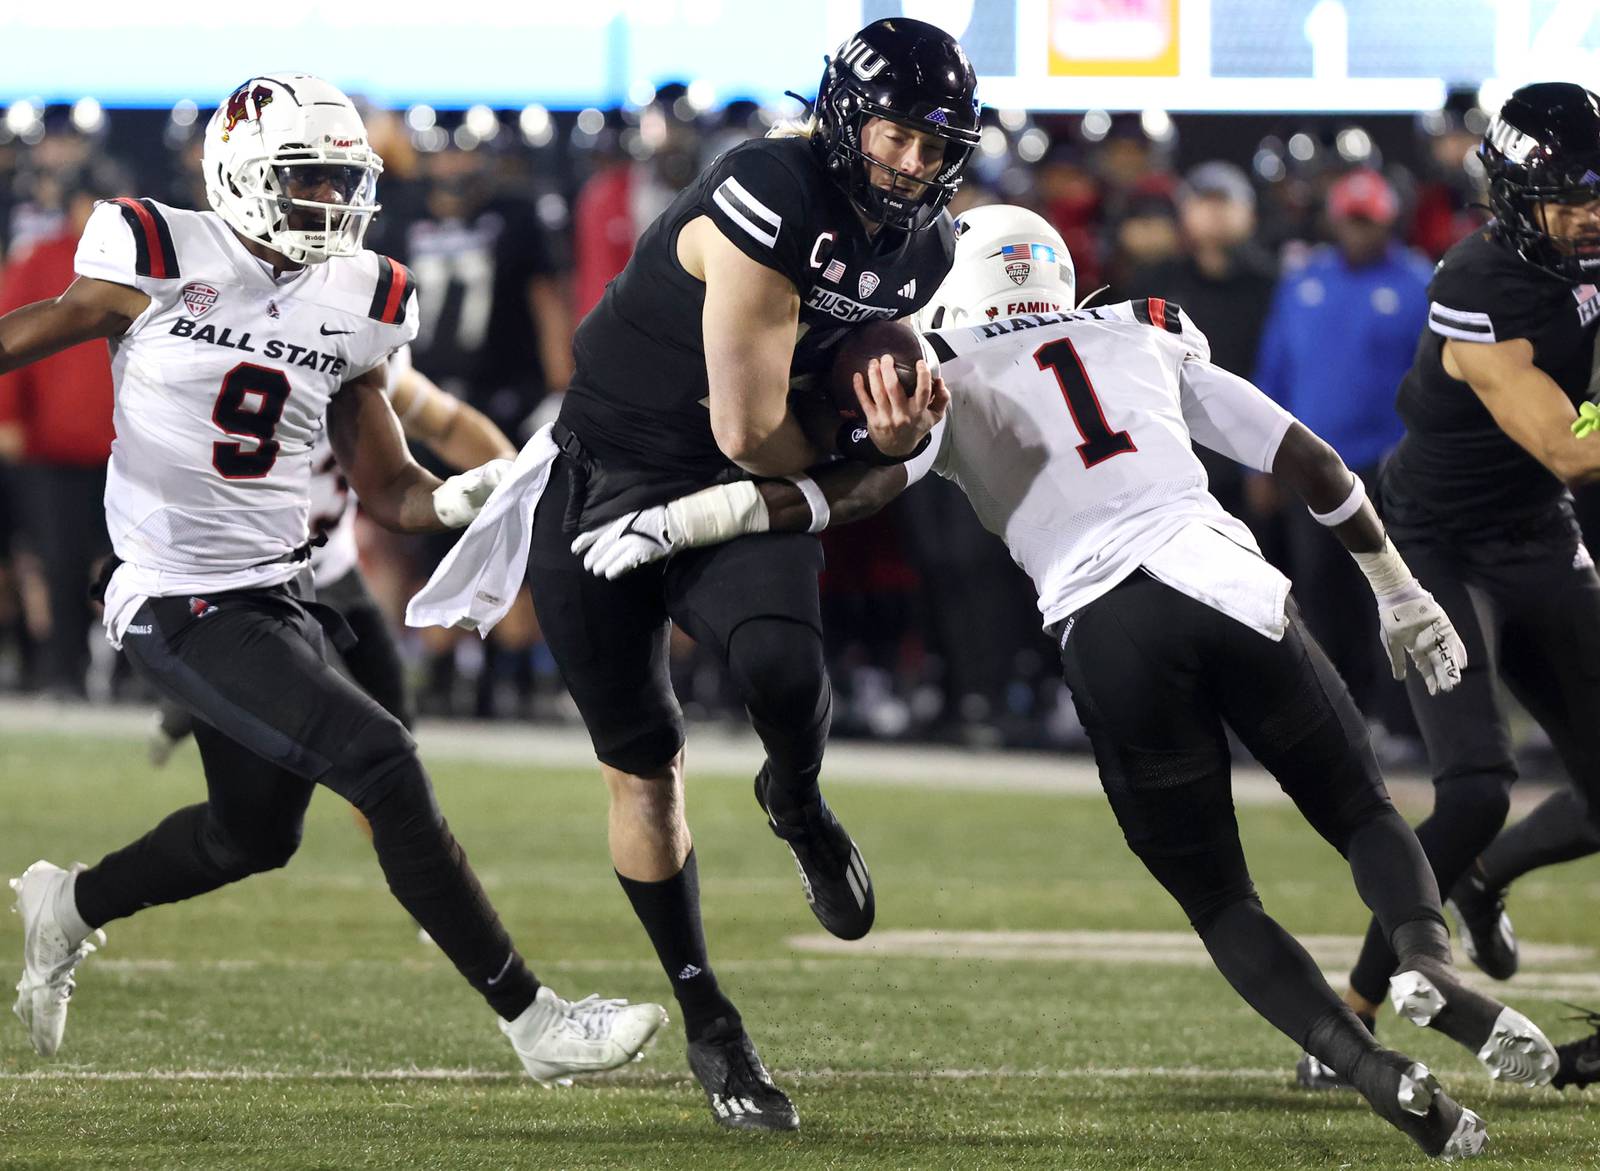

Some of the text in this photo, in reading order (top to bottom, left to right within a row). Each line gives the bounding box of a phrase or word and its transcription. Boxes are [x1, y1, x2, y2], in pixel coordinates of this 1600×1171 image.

[837, 35, 889, 81] NIU
[810, 232, 834, 269] C
[1008, 269, 1030, 277] MAC
[184, 292, 217, 305] MAC
[169, 318, 348, 376] BALL STATE
[212, 361, 292, 480] 9
[1033, 337, 1138, 469] 1
